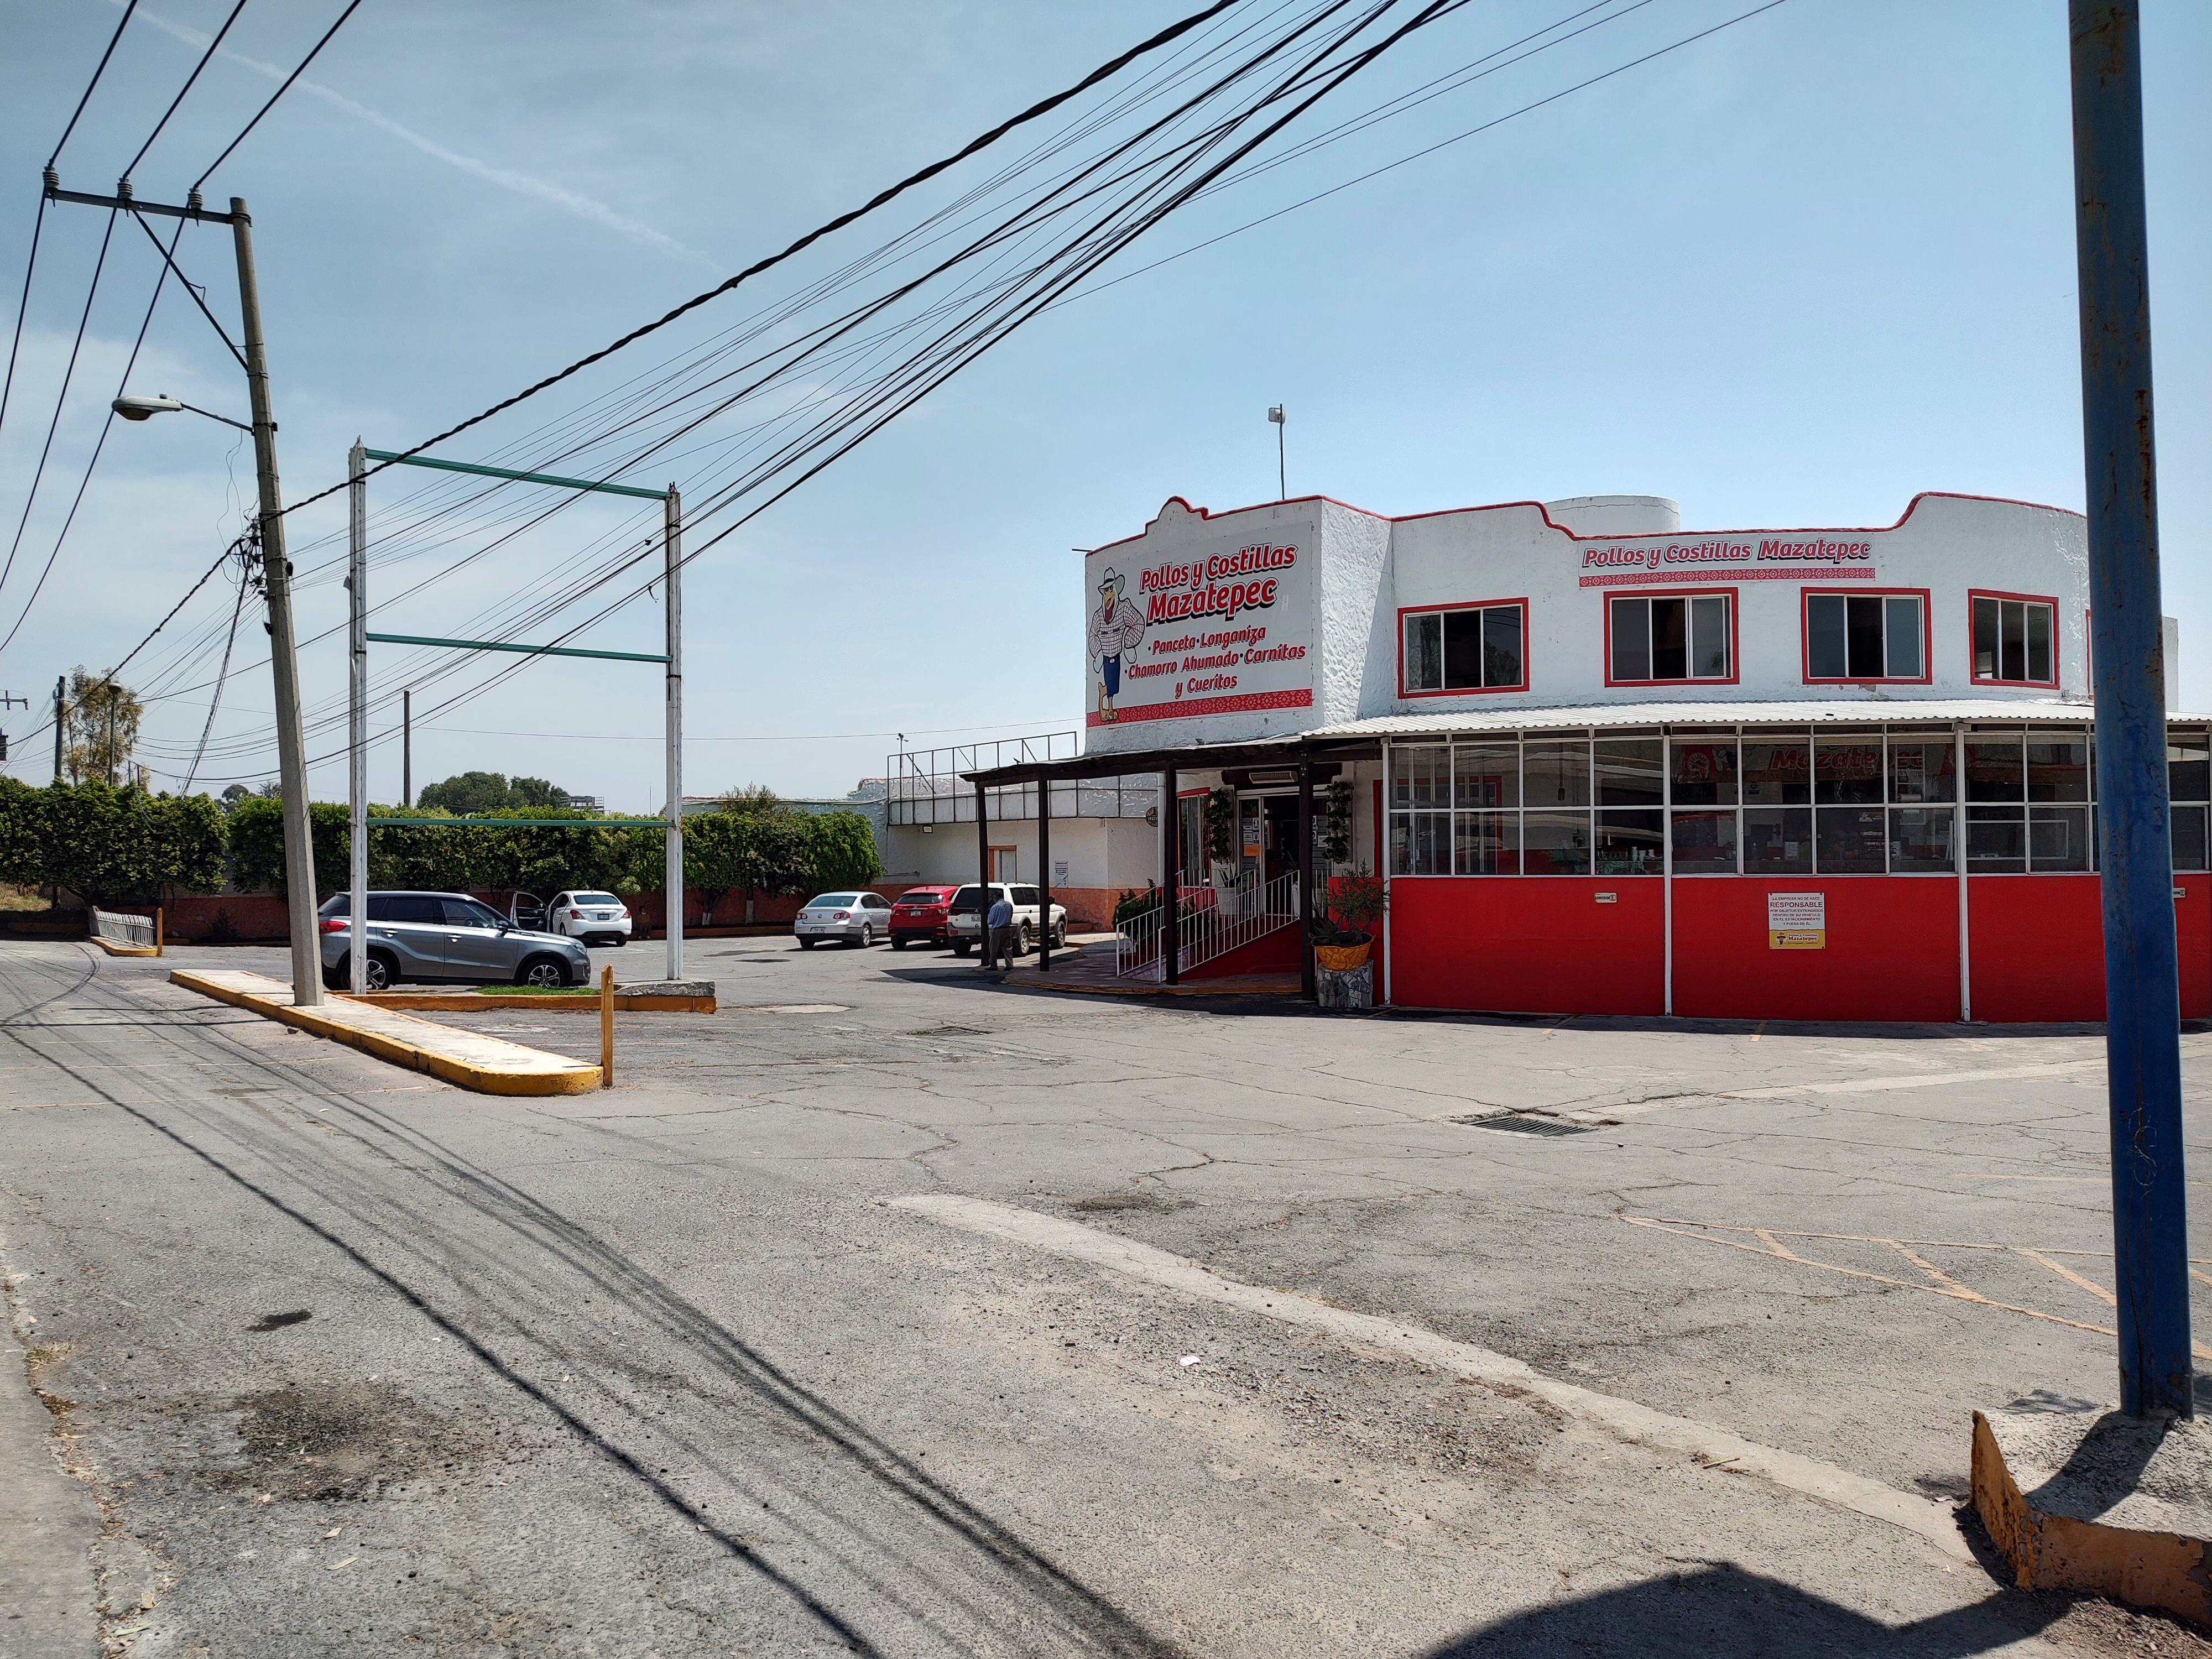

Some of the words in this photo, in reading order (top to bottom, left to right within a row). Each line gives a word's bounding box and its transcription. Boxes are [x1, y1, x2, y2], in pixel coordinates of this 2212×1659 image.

[1140, 562, 1191, 593] Pollos
[1191, 560, 1205, 589] y
[1206, 542, 1298, 580] Costillas
[1582, 546, 1647, 567] Pollos
[1647, 547, 1663, 569] y
[1665, 540, 1754, 562] Costillas
[1757, 538, 1872, 564] Mazatepec
[1146, 577, 1280, 626] Mazatepec
[1152, 634, 1196, 655] Panceta
[1201, 624, 1266, 650] Longaniza
[1129, 661, 1177, 679] Chamorro
[1181, 650, 1239, 672] Ahumado
[1244, 643, 1306, 664] Carnitas
[1175, 681, 1183, 700] y
[1188, 674, 1238, 693] Cueritos
